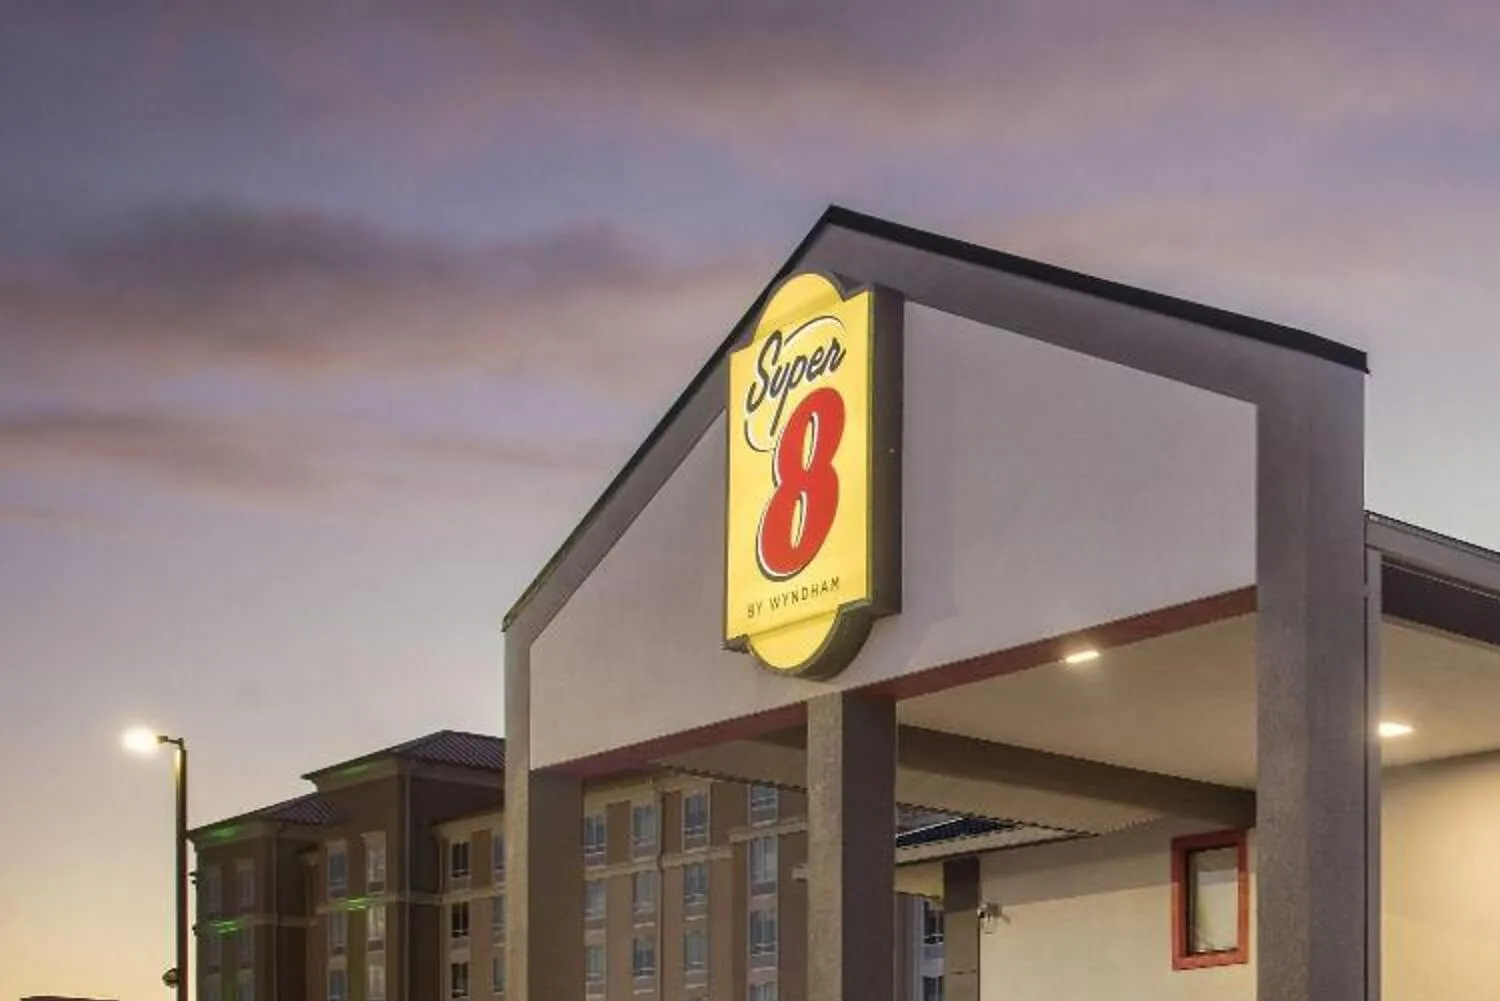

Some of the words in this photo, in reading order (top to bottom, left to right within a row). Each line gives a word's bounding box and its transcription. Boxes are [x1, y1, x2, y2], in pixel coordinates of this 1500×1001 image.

[746, 331, 846, 437] Super
[756, 387, 845, 582] 8
[747, 601, 763, 619] BY
[770, 575, 840, 612] WYNDHAM
